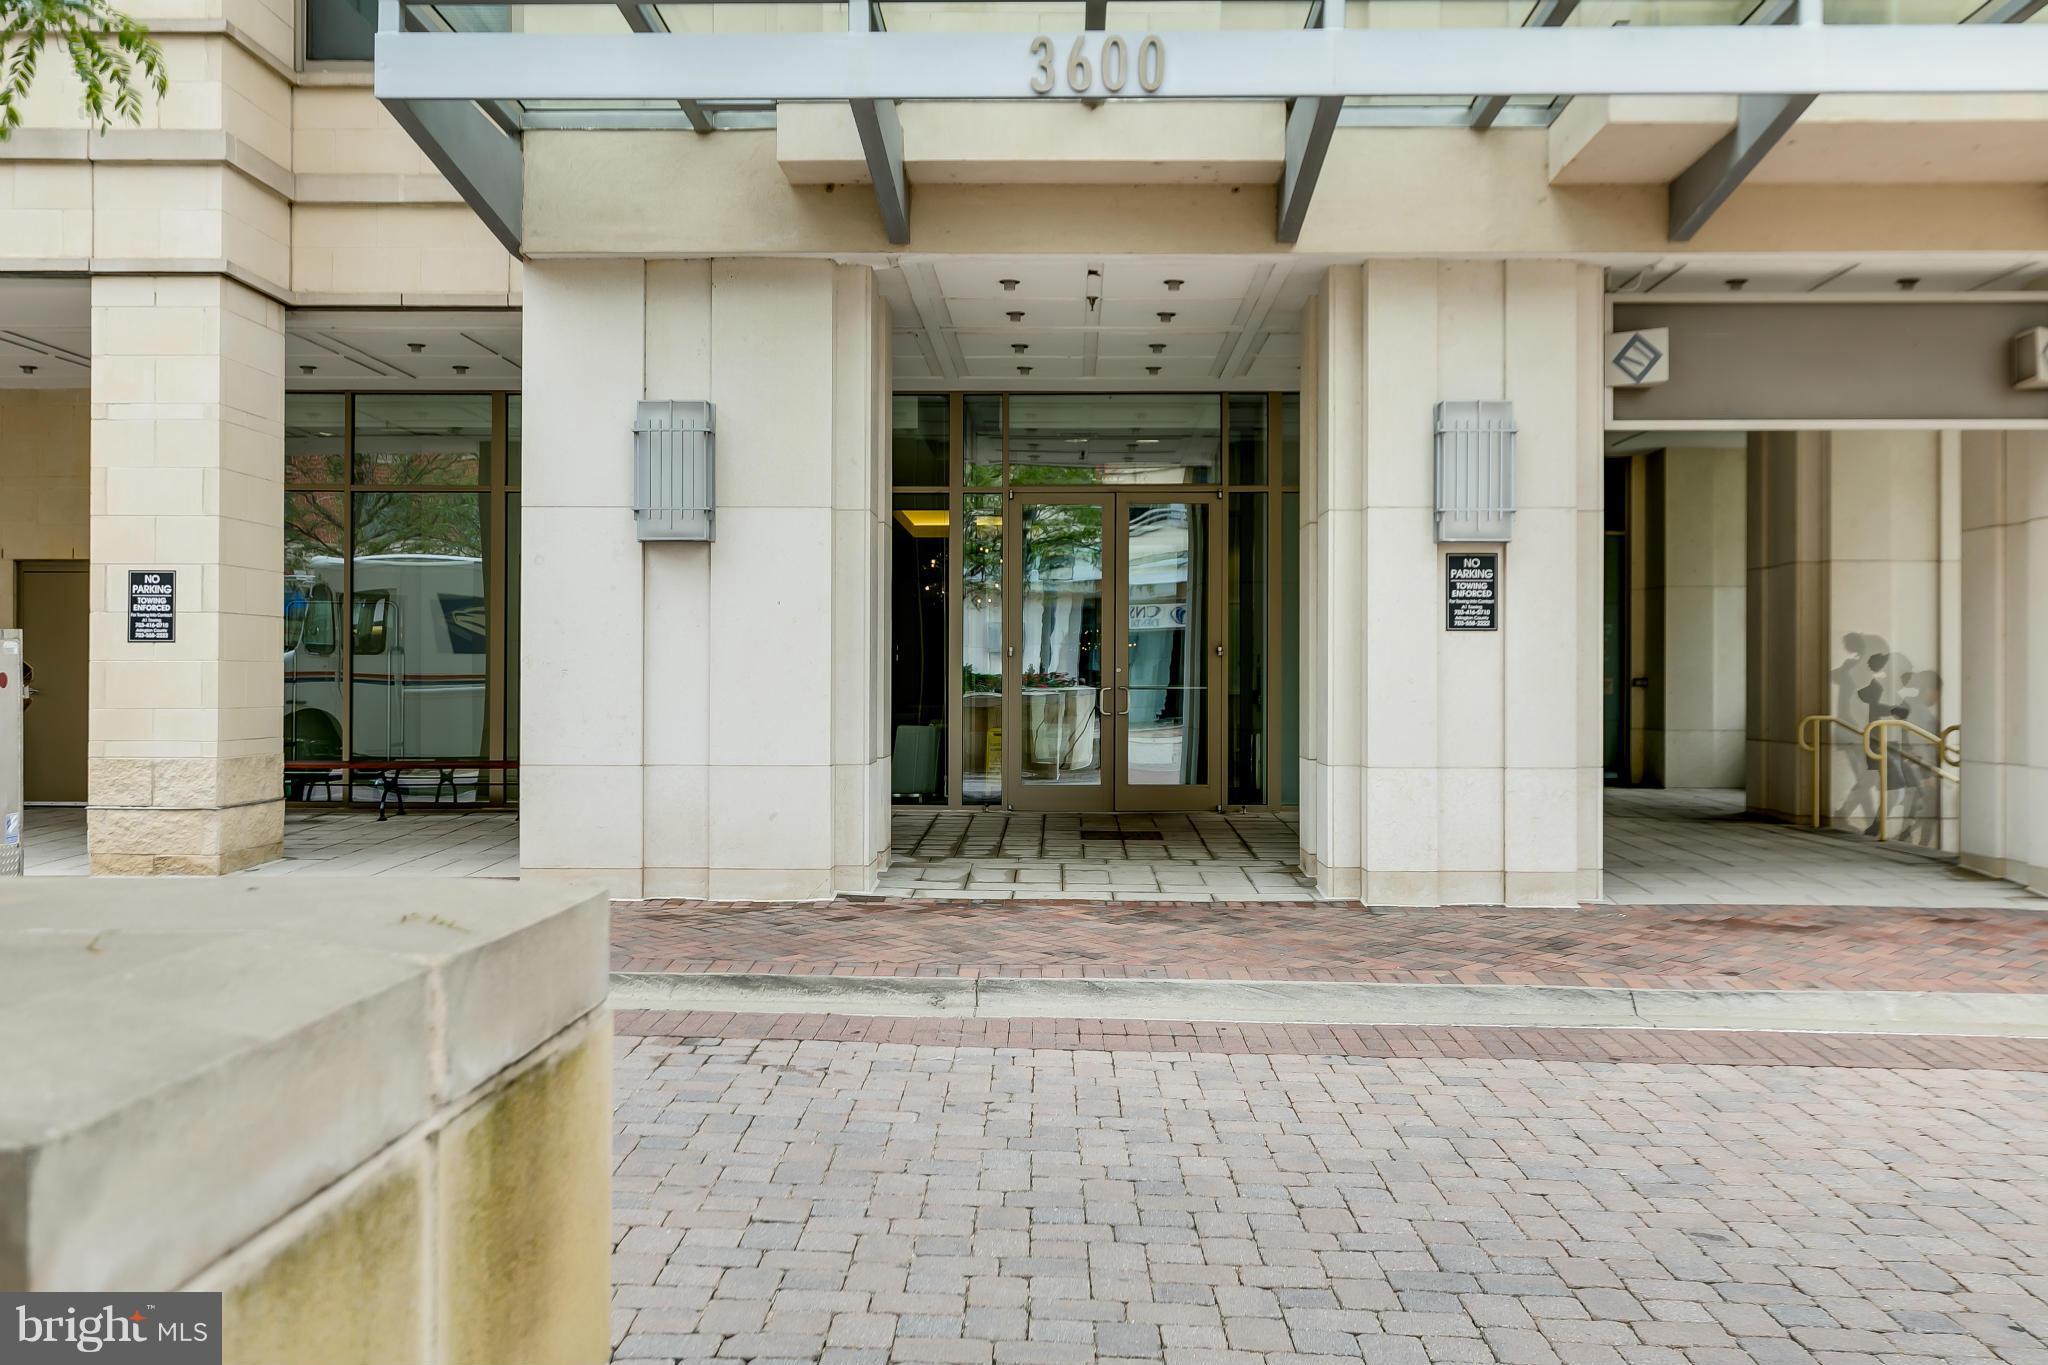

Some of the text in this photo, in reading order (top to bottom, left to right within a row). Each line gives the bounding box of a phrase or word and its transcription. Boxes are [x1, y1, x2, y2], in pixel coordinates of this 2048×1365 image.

[1030, 35, 1165, 93] 3600
[1463, 558, 1481, 568] NO
[1450, 569, 1493, 579] PARKING
[144, 574, 160, 584] NO
[132, 585, 172, 594] PARKING
[1456, 582, 1488, 590] TOWING
[1451, 590, 1493, 598] ENFORCED
[133, 604, 171, 612] ENFORCED
